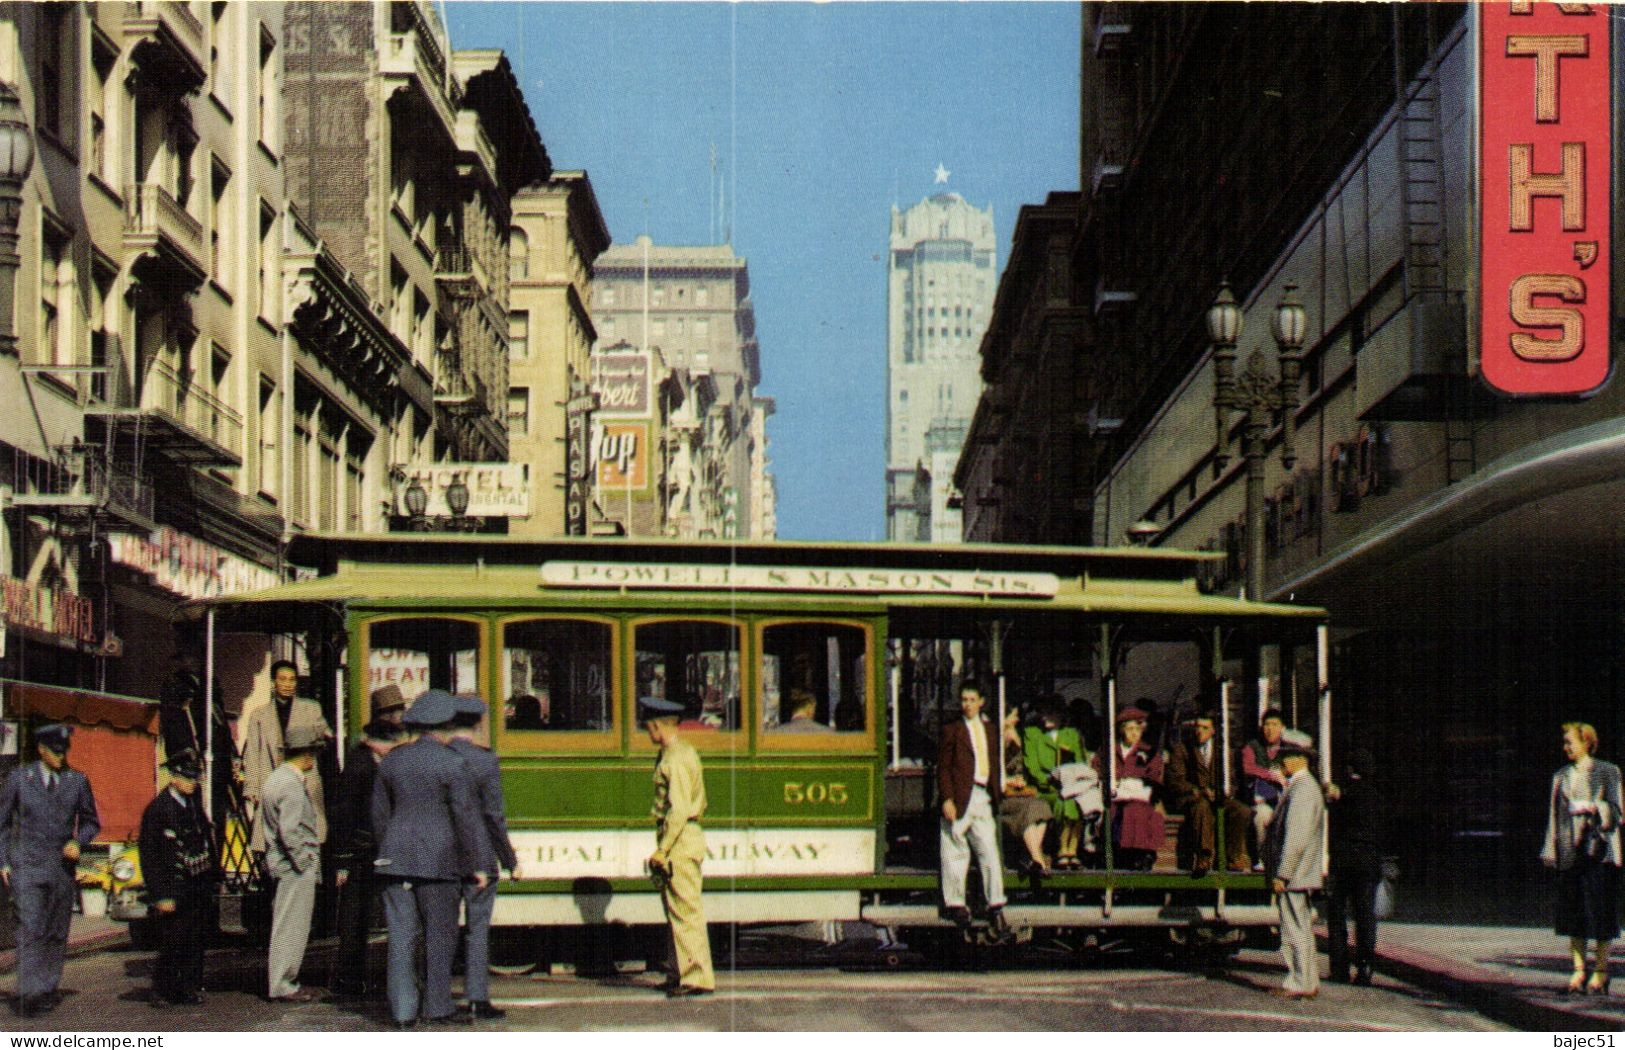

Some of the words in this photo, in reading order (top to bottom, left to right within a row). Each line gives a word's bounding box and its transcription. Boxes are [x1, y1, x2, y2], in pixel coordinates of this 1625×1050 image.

[1503, 2, 1599, 365] TH'S
[598, 379, 642, 407] bert
[414, 468, 514, 493] HOTEL
[572, 564, 746, 584] POWELL
[767, 569, 789, 585] &
[807, 570, 953, 589] MASON
[369, 666, 428, 682] HEAT
[783, 782, 849, 806] 505
[518, 845, 620, 863] CIPAL
[704, 843, 828, 860] AILWAY
